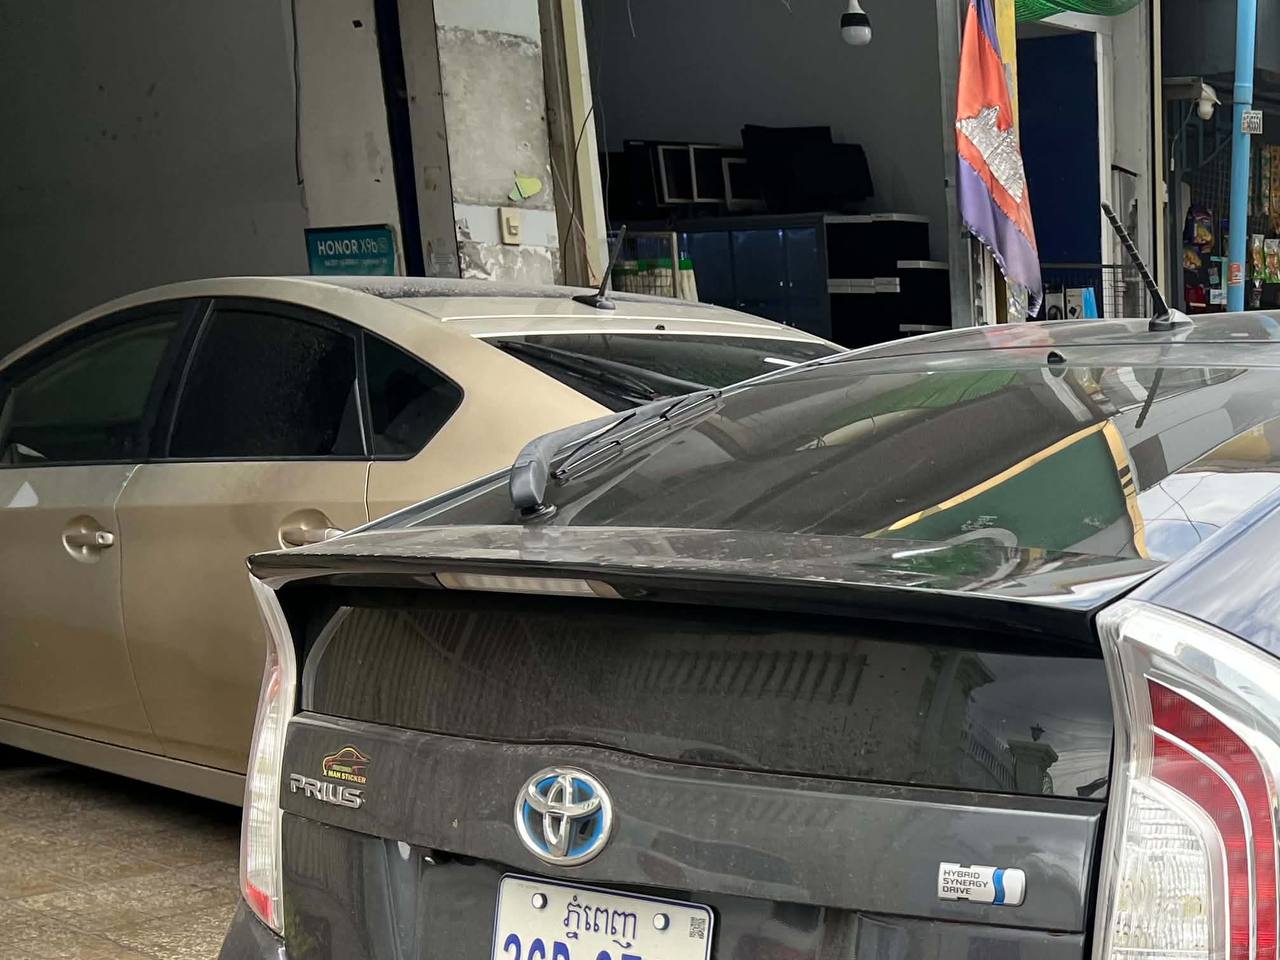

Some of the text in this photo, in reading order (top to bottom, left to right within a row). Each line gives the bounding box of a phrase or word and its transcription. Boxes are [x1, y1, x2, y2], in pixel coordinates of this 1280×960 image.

[317, 240, 358, 256] HONOR
[342, 773, 367, 784] STICKER
[289, 772, 364, 809] PRIUS
[943, 870, 980, 879] HYBRID
[943, 878, 988, 887] SYNERGY
[942, 886, 971, 894] DRIVE
[563, 894, 637, 949] ភ្នំពេញ
